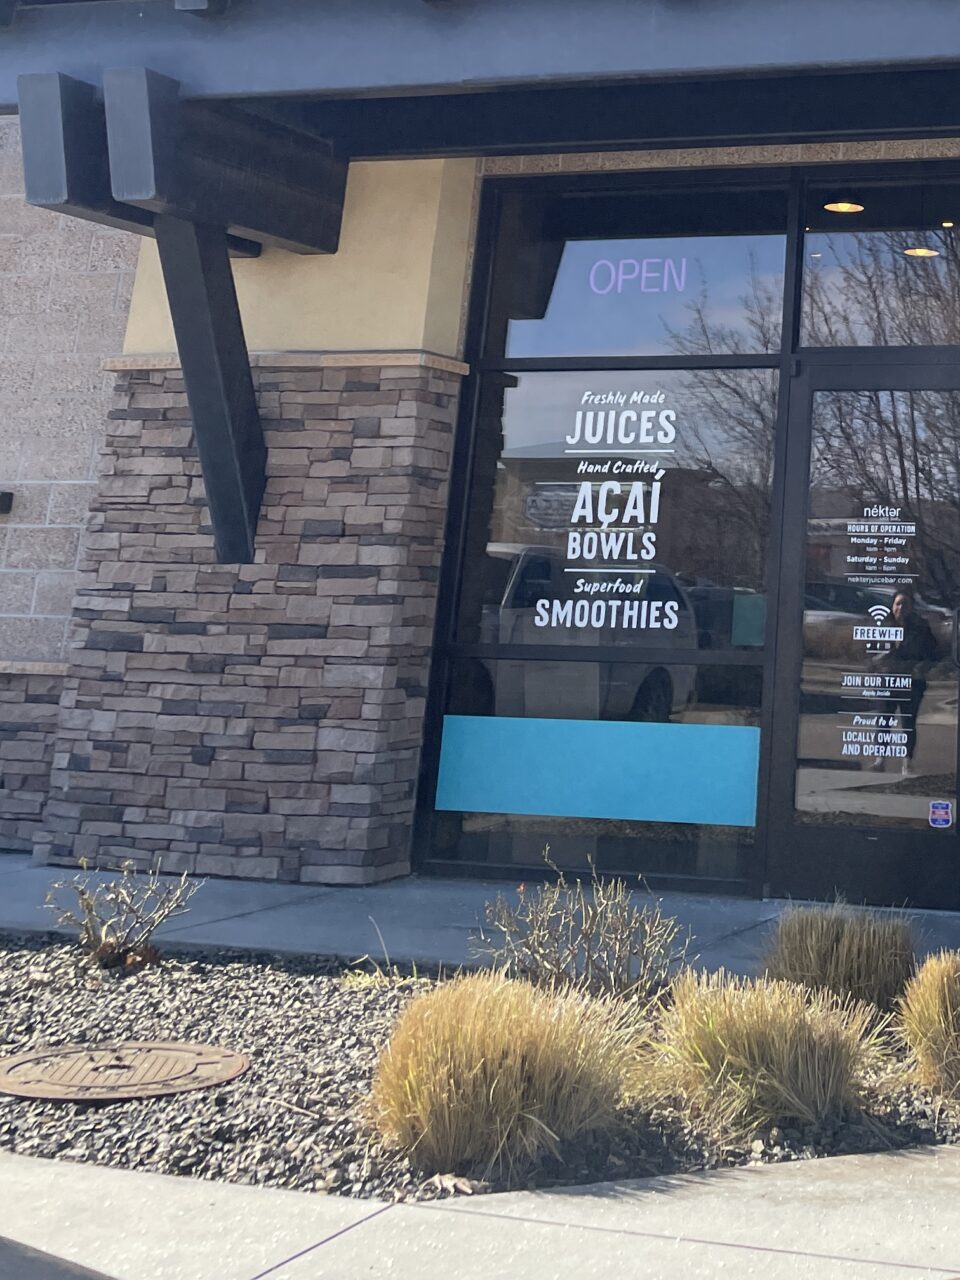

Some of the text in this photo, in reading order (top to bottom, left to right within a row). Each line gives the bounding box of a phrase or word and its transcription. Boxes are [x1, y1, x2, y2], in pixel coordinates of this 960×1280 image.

[589, 258, 687, 294] OPEN
[581, 390, 666, 406] Freshly Made
[565, 409, 677, 445] JUICES
[577, 460, 659, 474] Hand Crafted
[570, 469, 666, 529] AÇAÍ
[863, 504, 902, 517] néktər
[847, 524, 916, 534] HOURS OF OPERATION
[567, 531, 656, 560] BOWLS
[850, 537, 878, 545] Monday
[884, 537, 907, 546] Friday
[846, 555, 878, 564] Saturday
[883, 556, 910, 565] Sunday
[574, 578, 644, 595] Superfood
[534, 599, 679, 630] SMOOTHIES
[855, 628, 903, 640] FREE WI-FI
[841, 676, 912, 689] JOIN OUR TEAM!
[853, 715, 898, 727] Proud to be
[842, 731, 908, 744] LOCALLY OWNED
[841, 743, 908, 757] AND OPERATED
